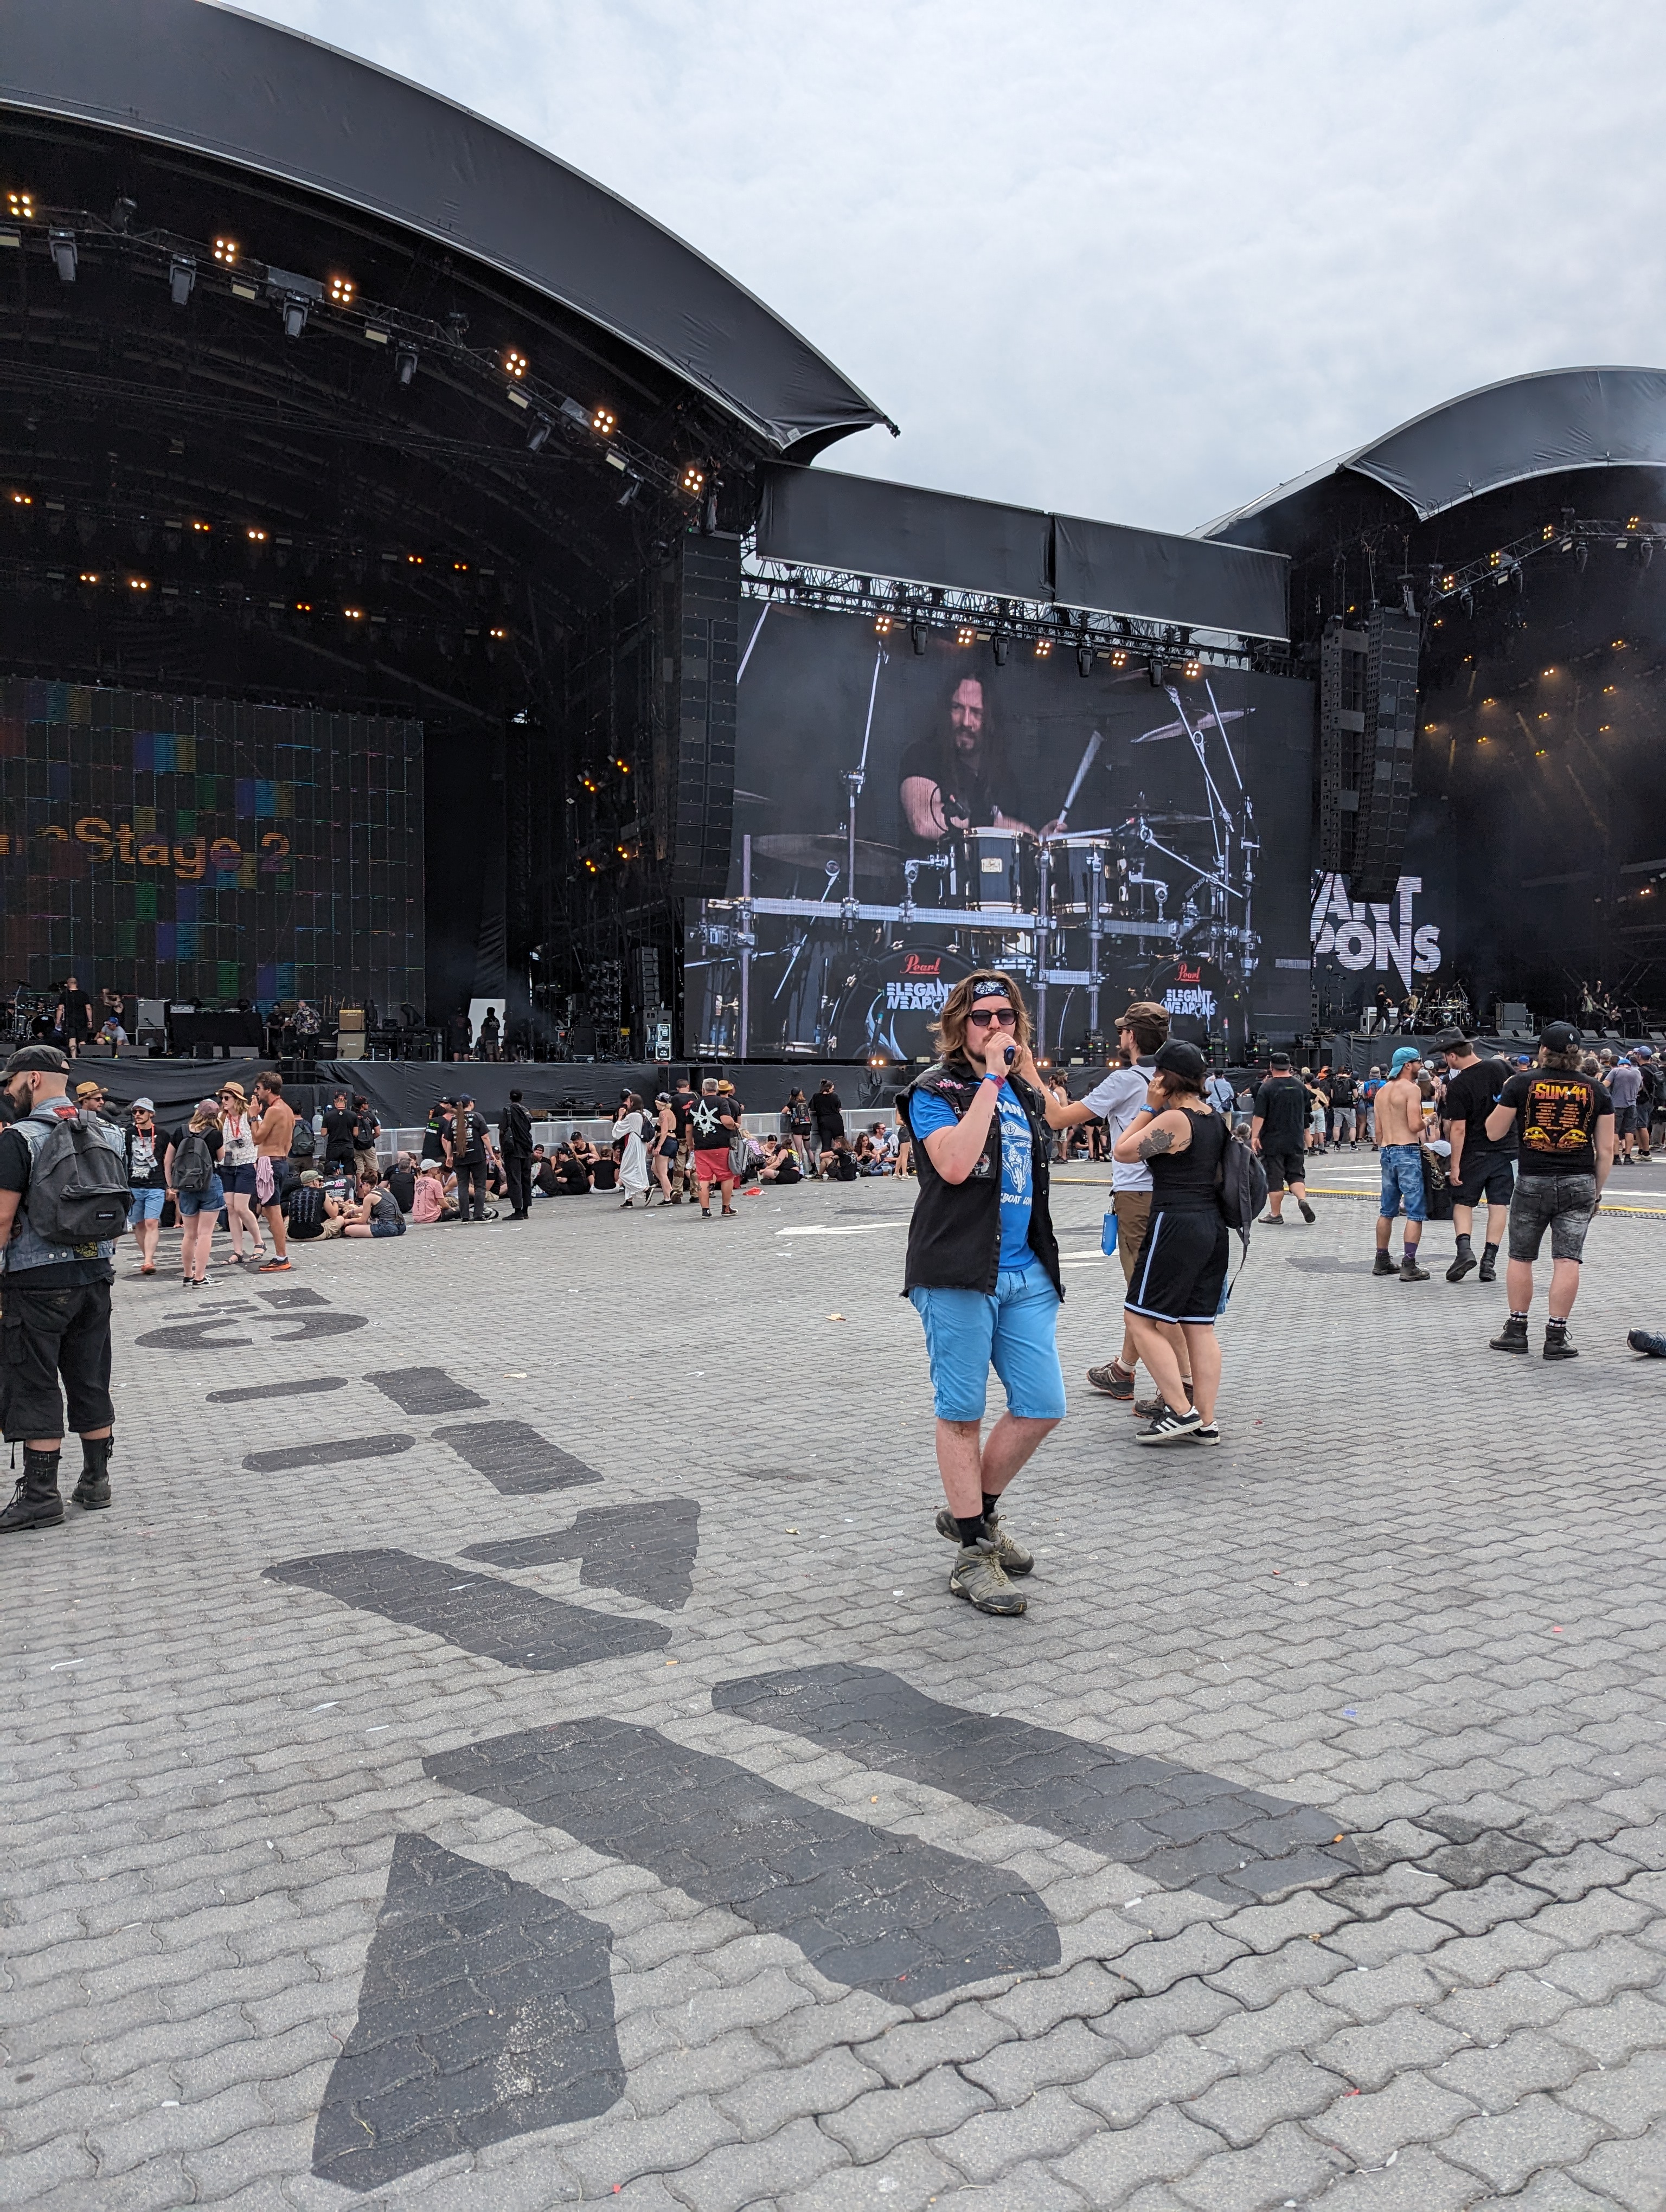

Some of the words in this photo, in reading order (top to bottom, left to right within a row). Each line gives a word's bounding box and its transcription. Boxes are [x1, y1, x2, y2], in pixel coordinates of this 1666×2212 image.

[261, 832, 291, 872] 2
[900, 953, 941, 974] Pearl
[1174, 962, 1201, 982] Pearl
[1166, 985, 1212, 1002] ELEGANT
[1164, 1001, 1216, 1020] WEAPONS
[1532, 1083, 1568, 1100] SUM
[1569, 1085, 1588, 1108] 41
